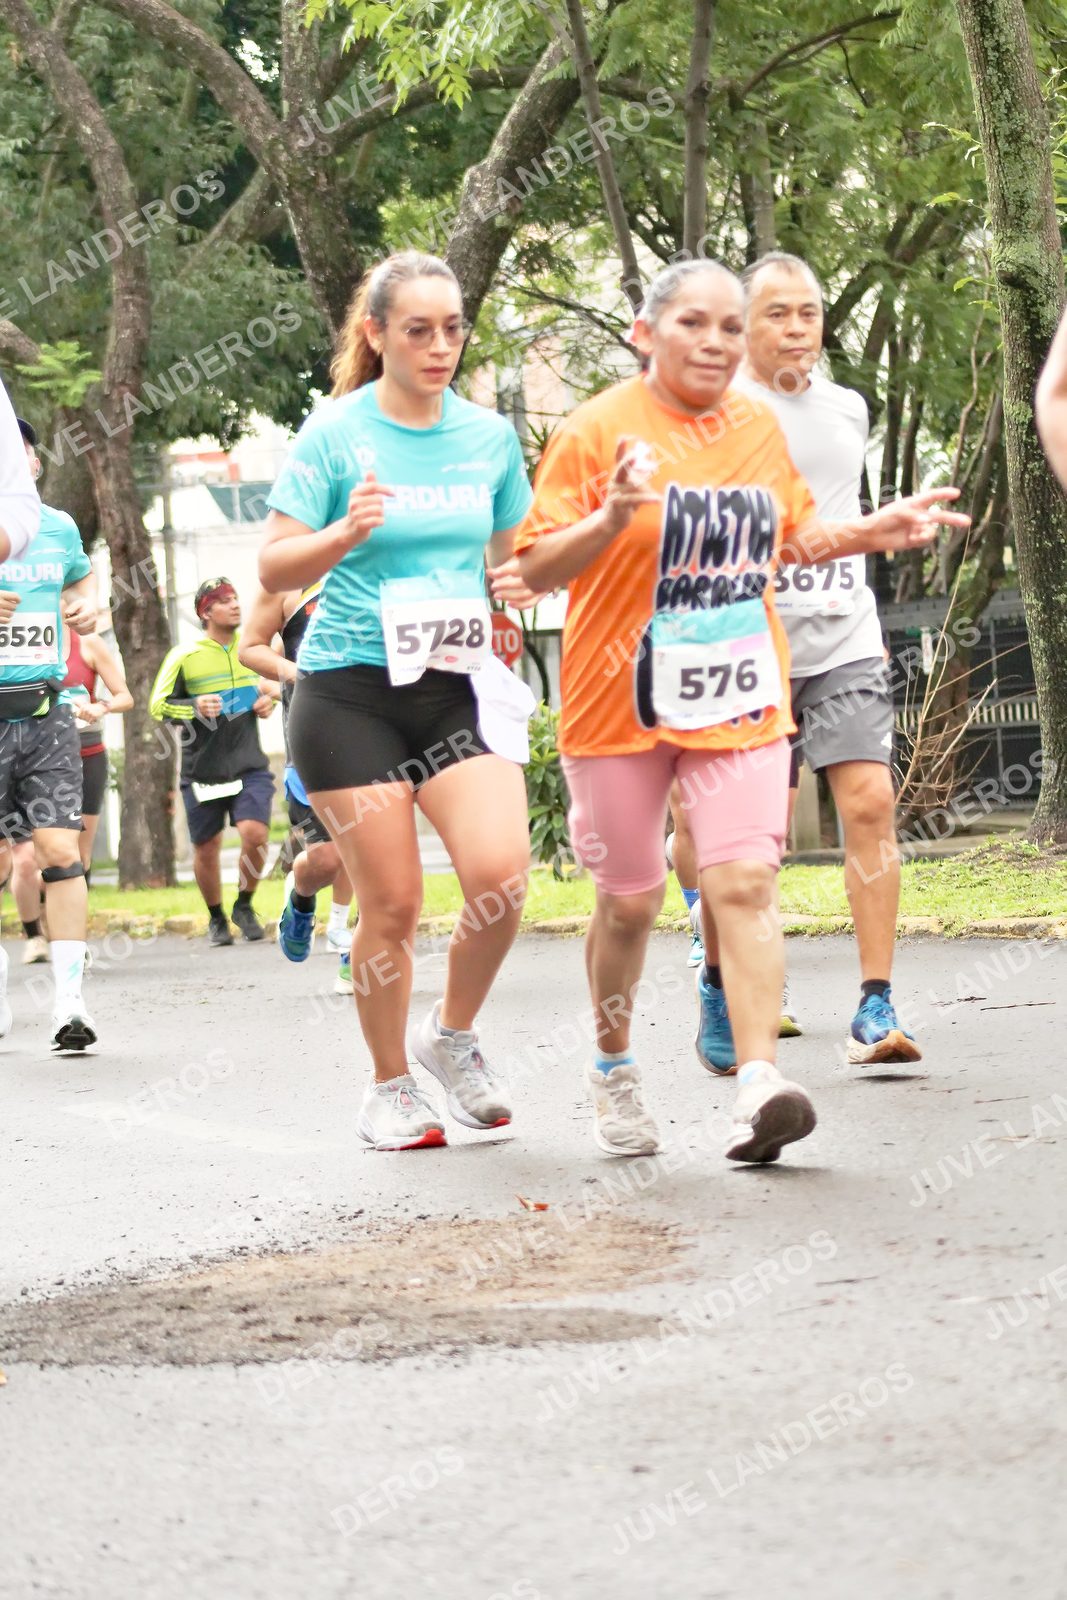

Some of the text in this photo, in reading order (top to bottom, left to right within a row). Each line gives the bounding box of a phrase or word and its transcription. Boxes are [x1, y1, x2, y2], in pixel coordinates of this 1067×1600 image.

[382, 483, 491, 512] ERDURA
[396, 617, 485, 655] 5728
[678, 658, 759, 701] 576
